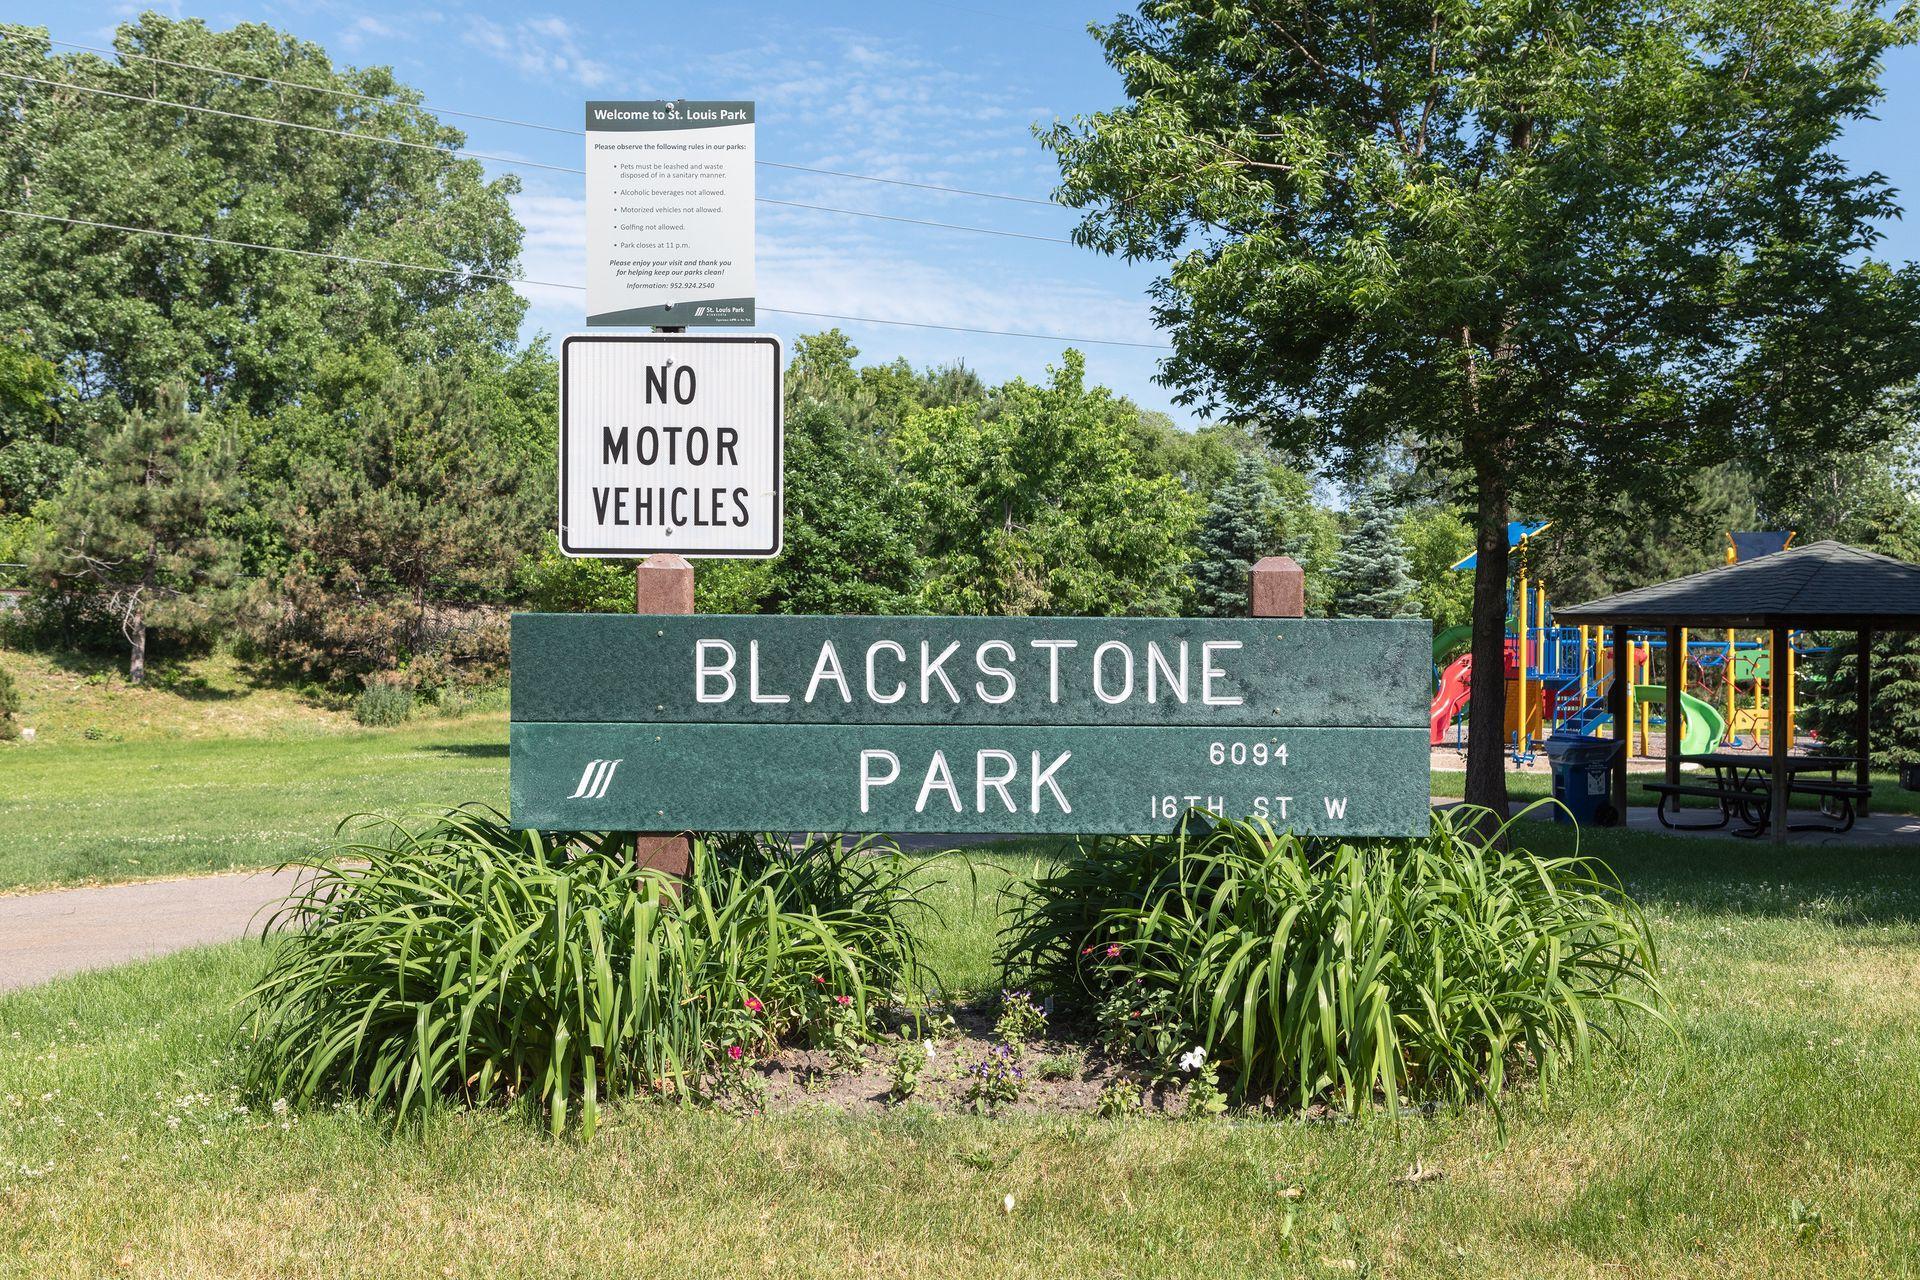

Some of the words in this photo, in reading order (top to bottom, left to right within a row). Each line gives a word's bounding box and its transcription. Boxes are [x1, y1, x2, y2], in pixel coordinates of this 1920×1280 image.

[594, 110, 650, 120] Welcome
[652, 110, 665, 120] to
[667, 109, 683, 120] St.
[687, 110, 718, 120] Louis
[721, 110, 747, 120] Park
[656, 143, 687, 152] following
[726, 143, 746, 152] parks:
[620, 172, 649, 180] disposed
[672, 172, 698, 180] sanitary
[651, 189, 684, 197] beverages
[620, 224, 644, 232] Golfing
[632, 260, 651, 268] enjoy
[616, 269, 626, 277] for
[627, 269, 653, 277] helping
[654, 269, 670, 277] keep
[684, 269, 703, 277] parks
[645, 365, 697, 405] NO
[603, 426, 739, 466] MOTOR
[592, 486, 750, 528] VEHICLES
[694, 637, 1245, 707] BLACKSTONE
[1209, 741, 1289, 766] 6094
[859, 748, 1073, 816] PARK
[1253, 796, 1294, 820] ST
[1323, 796, 1348, 820] W
